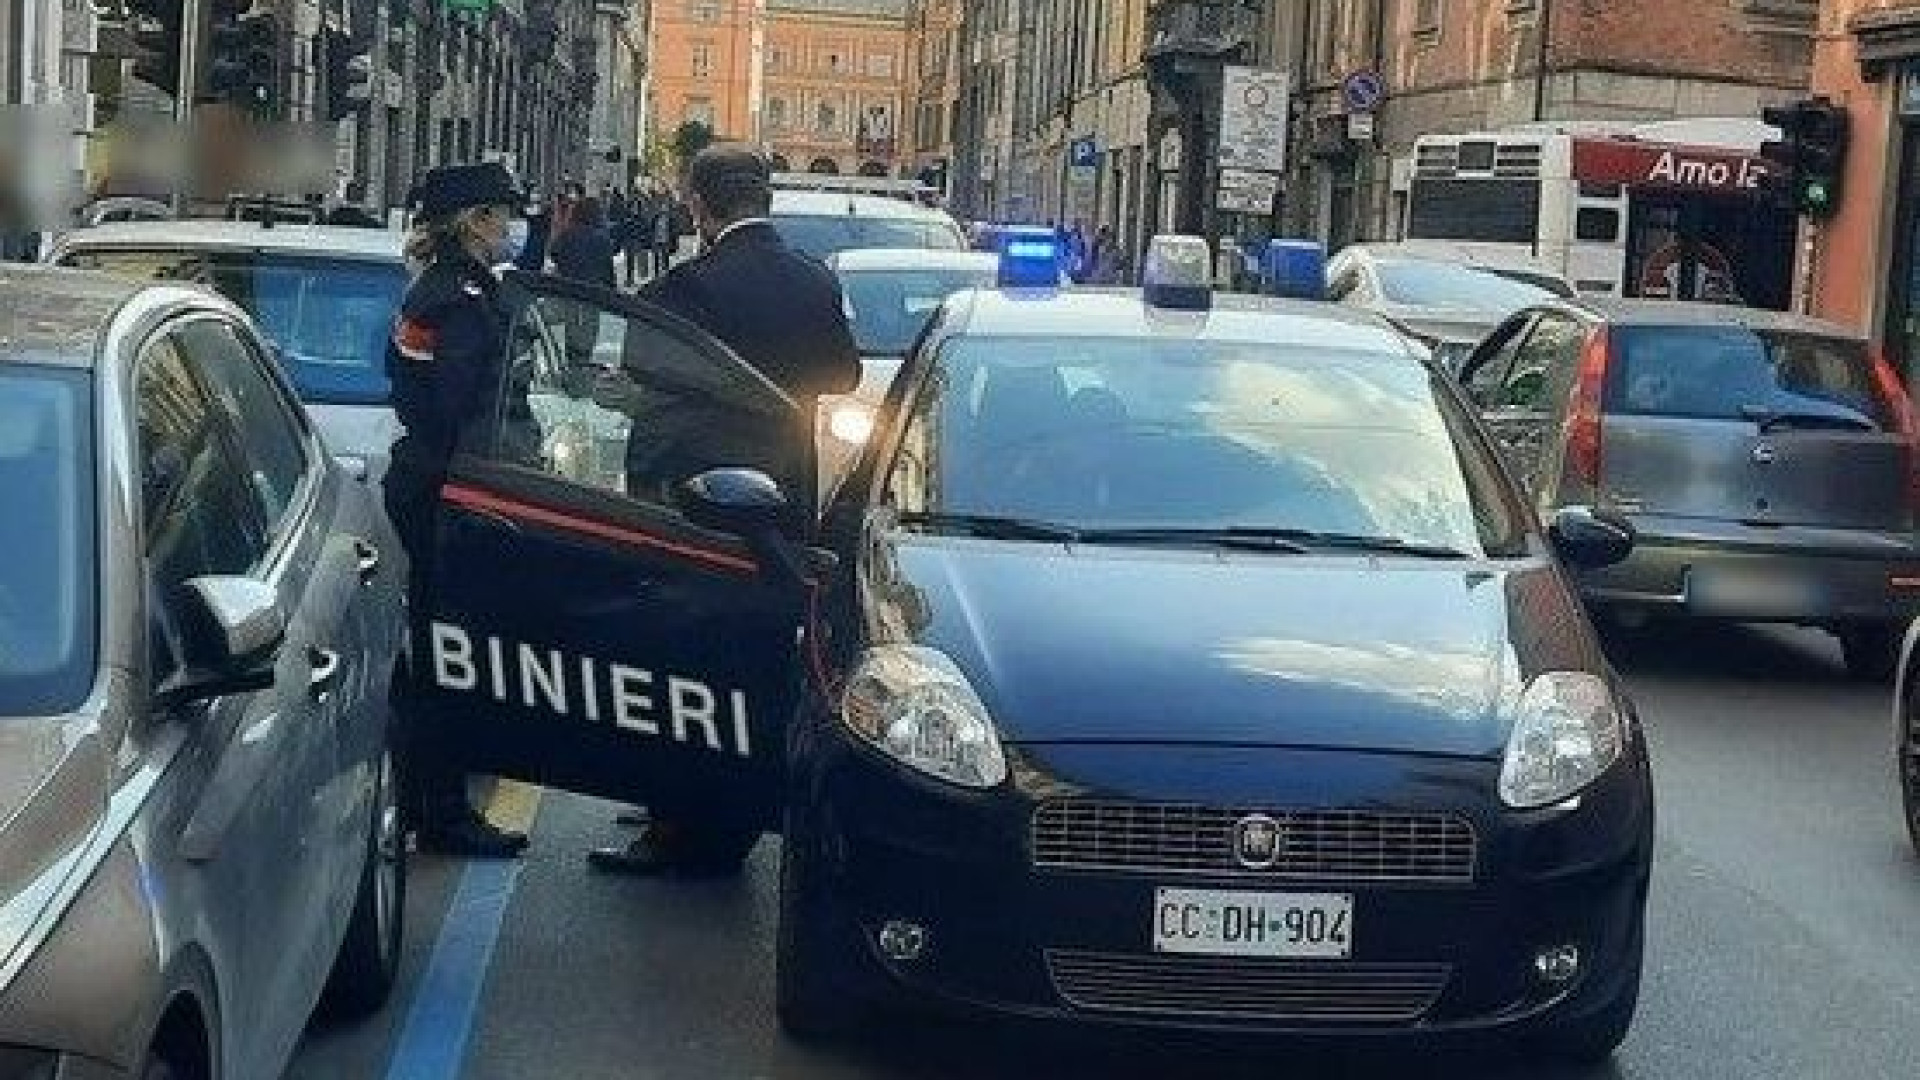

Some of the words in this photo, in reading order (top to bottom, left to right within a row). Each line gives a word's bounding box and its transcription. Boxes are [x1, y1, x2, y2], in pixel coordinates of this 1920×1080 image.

[1076, 141, 1090, 161] P
[1649, 151, 1730, 185] Amo
[431, 620, 750, 757] BINIERI
